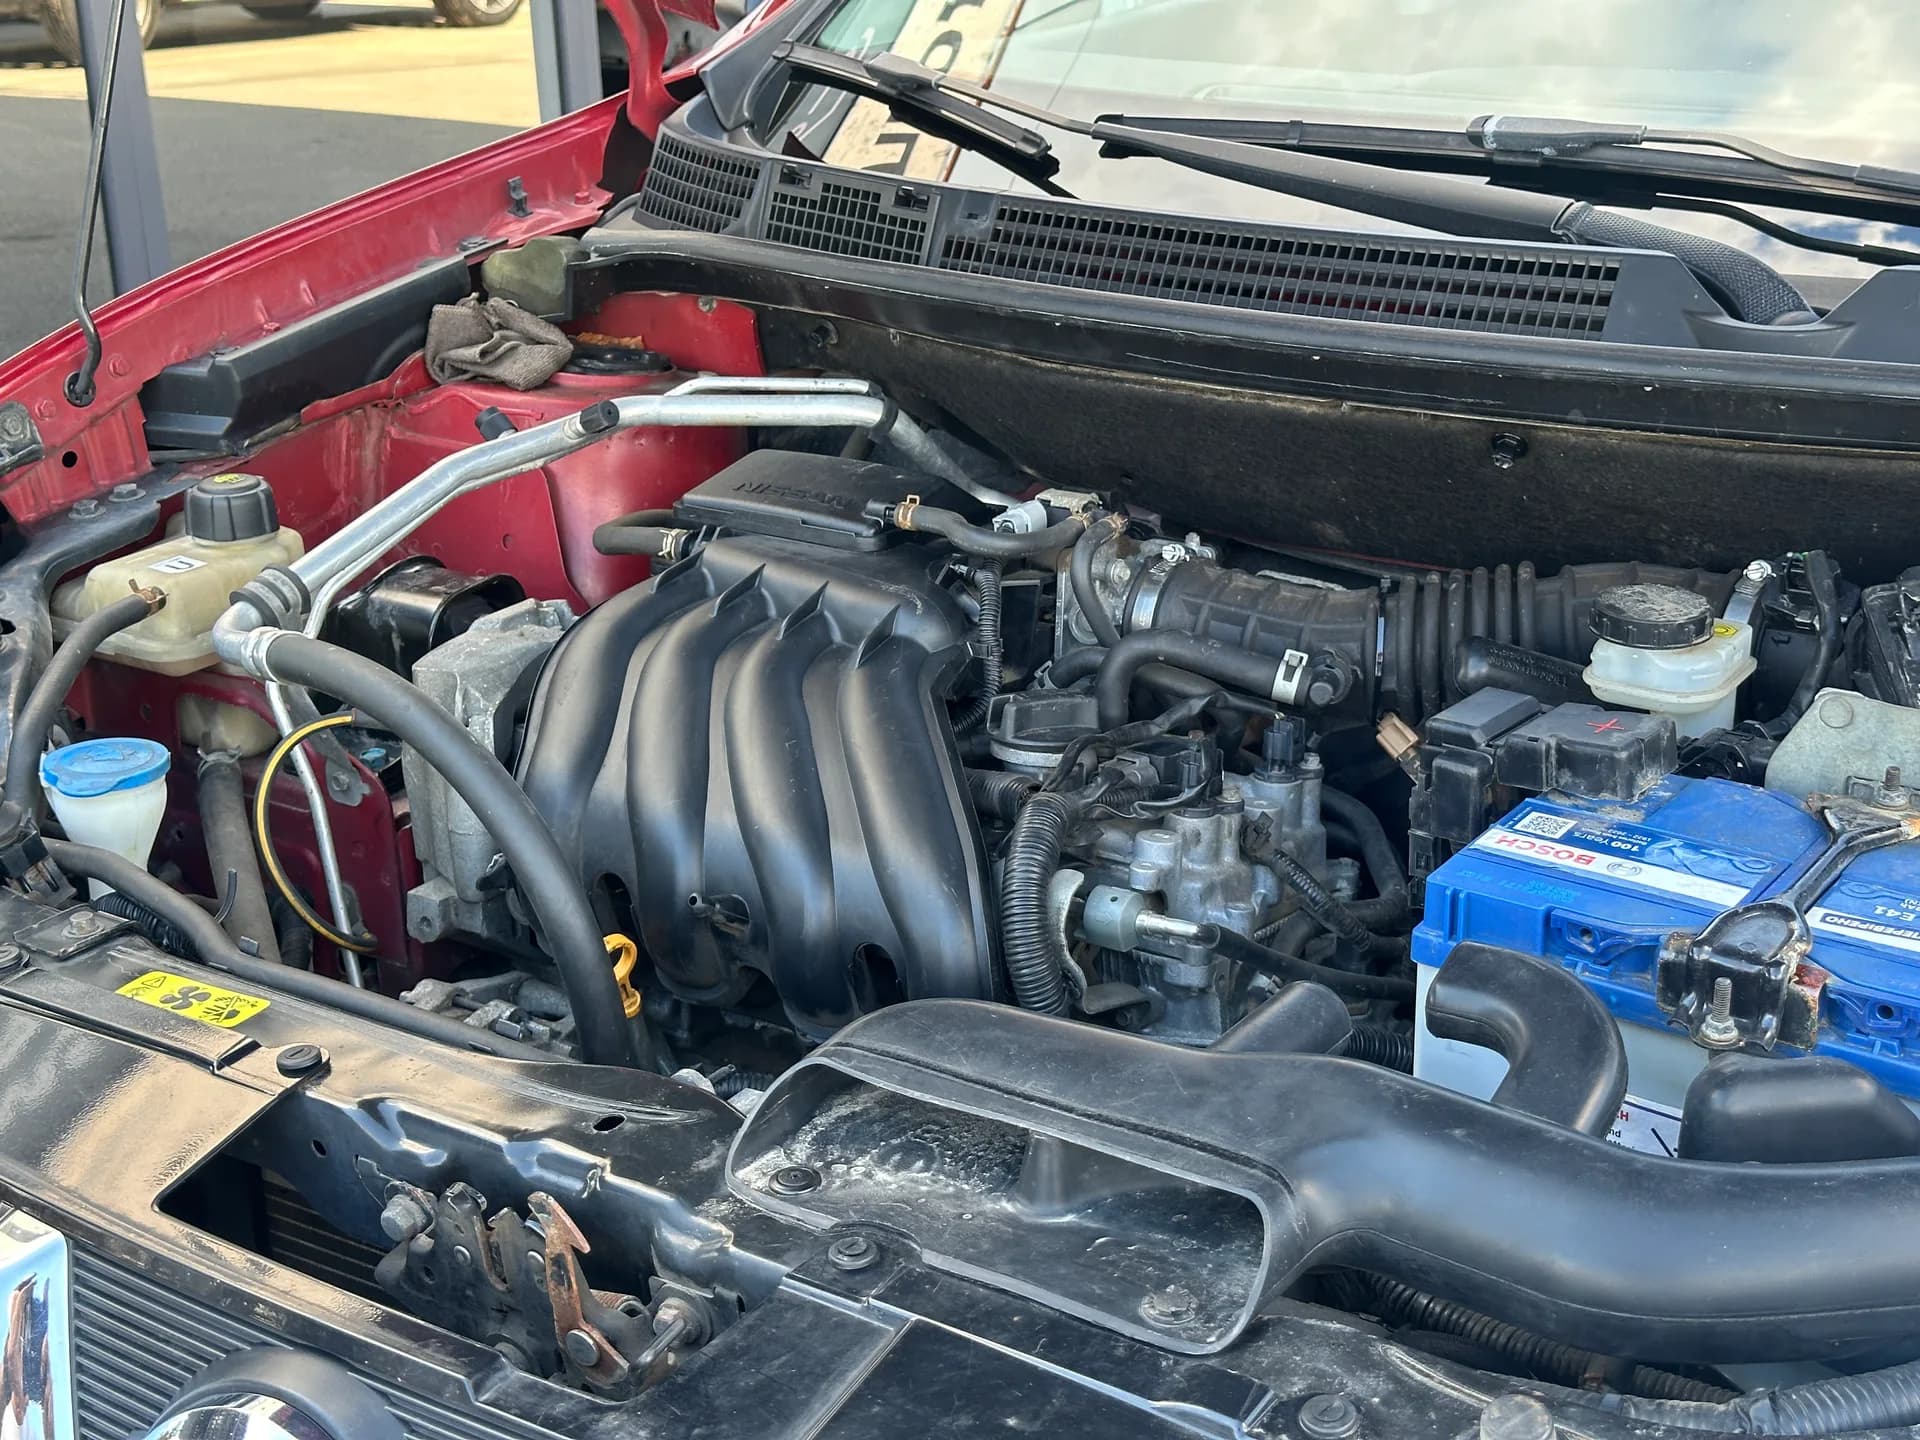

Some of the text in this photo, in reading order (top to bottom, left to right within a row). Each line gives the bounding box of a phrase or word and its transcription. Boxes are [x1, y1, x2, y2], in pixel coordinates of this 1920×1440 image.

[1496, 835, 1597, 865] BOSCH
[1572, 831, 1640, 852] 100 Years
[1873, 905, 1916, 921] E41
